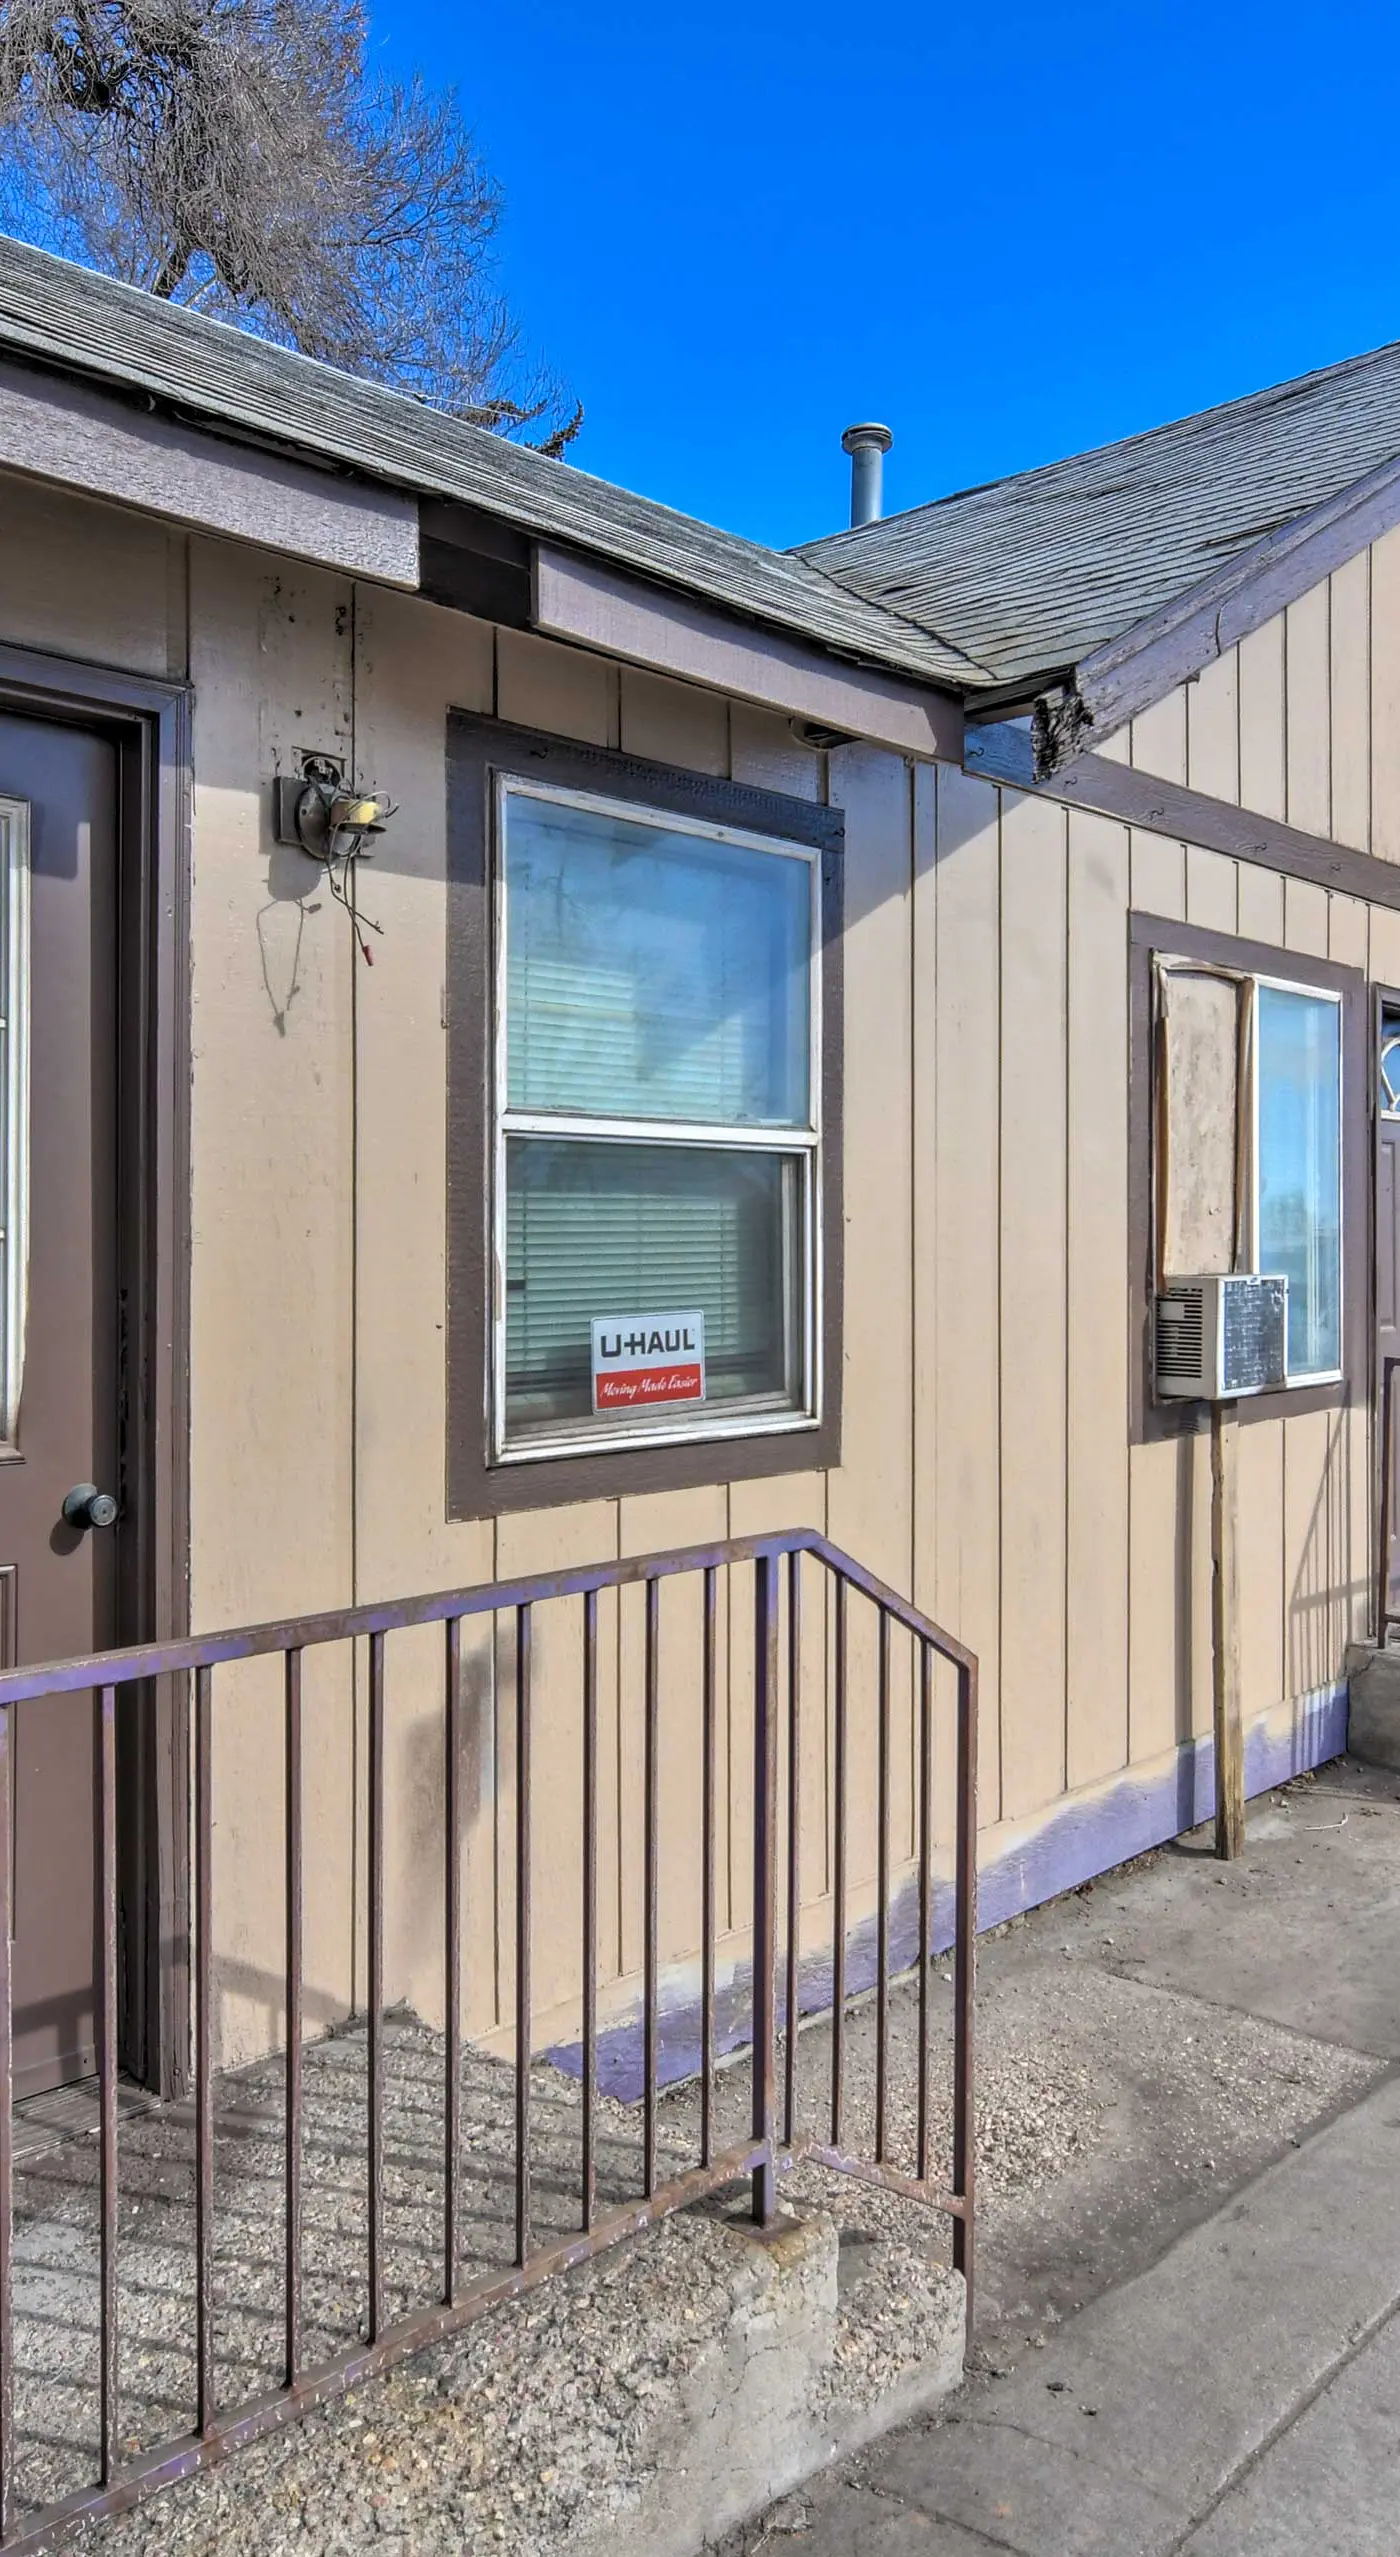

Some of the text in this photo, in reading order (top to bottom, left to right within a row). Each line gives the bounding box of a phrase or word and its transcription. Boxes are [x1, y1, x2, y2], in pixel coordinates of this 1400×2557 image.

[600, 1374, 698, 1399] Moving Made Easier
